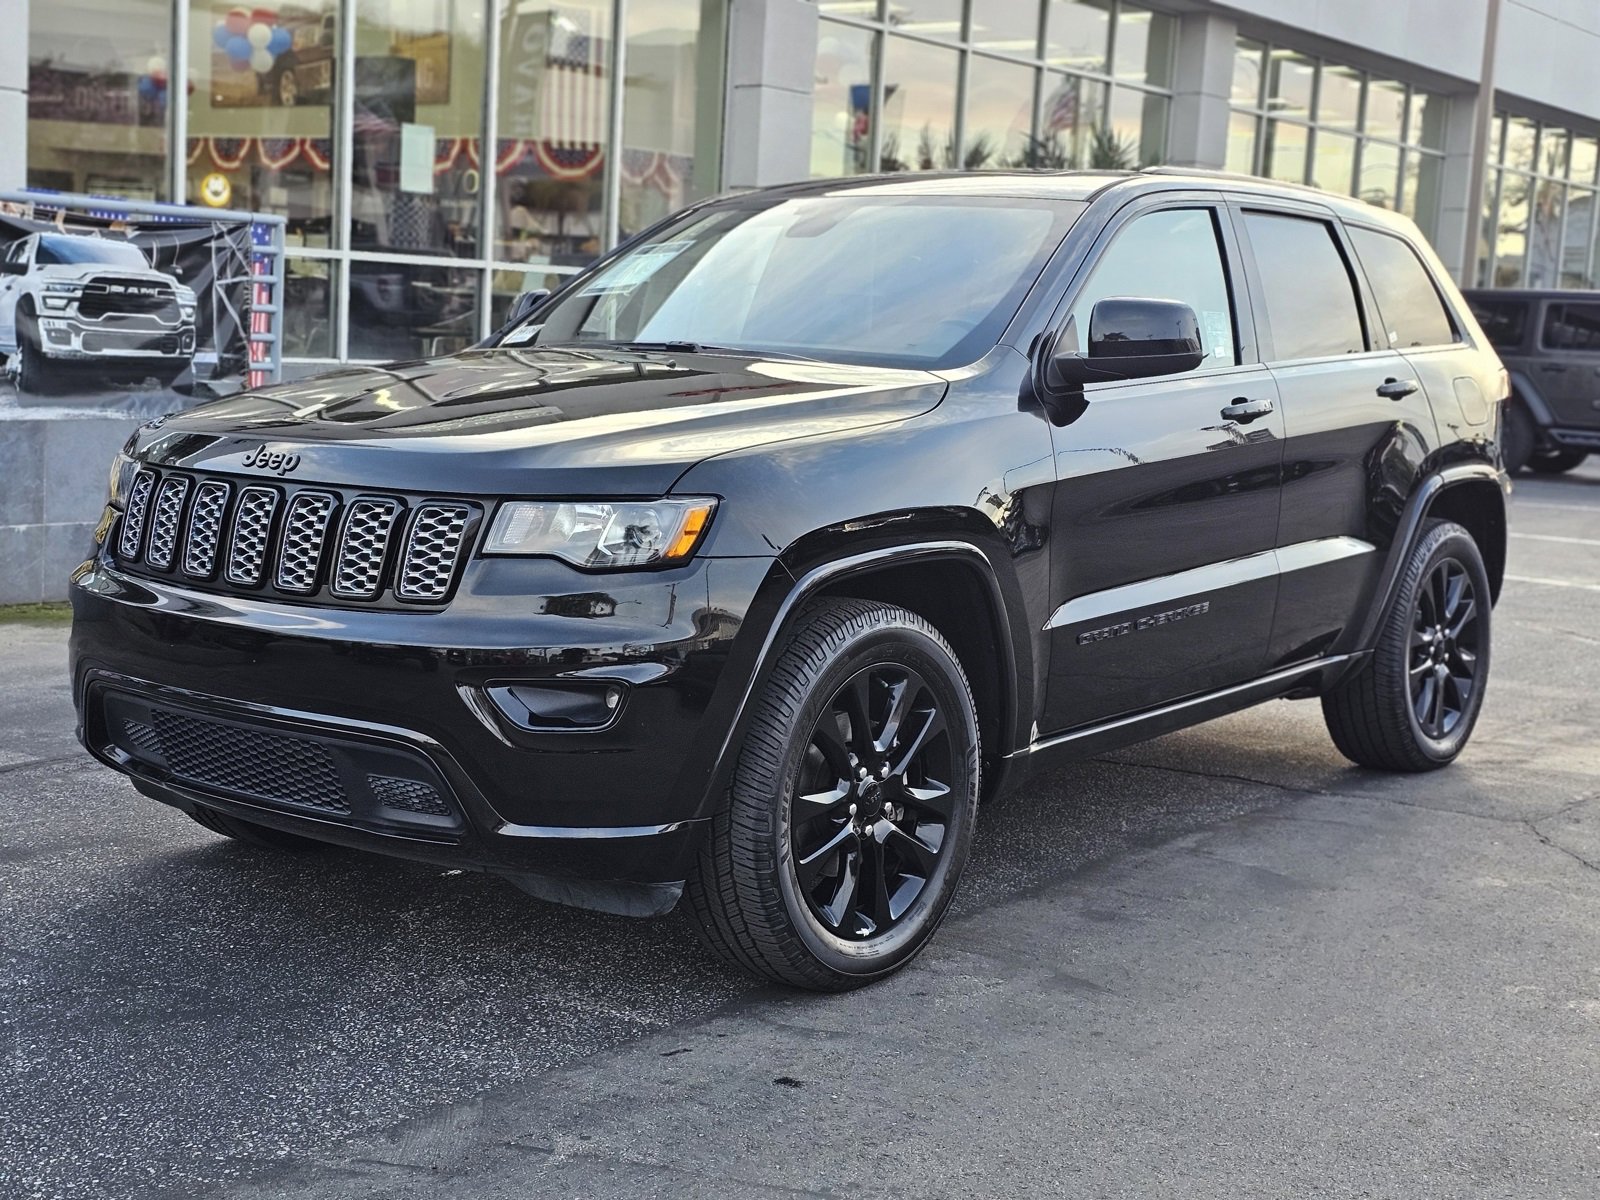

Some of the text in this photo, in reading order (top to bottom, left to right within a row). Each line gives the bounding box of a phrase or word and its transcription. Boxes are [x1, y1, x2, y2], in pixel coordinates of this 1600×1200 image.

[110, 284, 155, 296] RAM
[240, 444, 301, 477] Jeep
[1077, 601, 1210, 645] GRAND CHEROKEE
